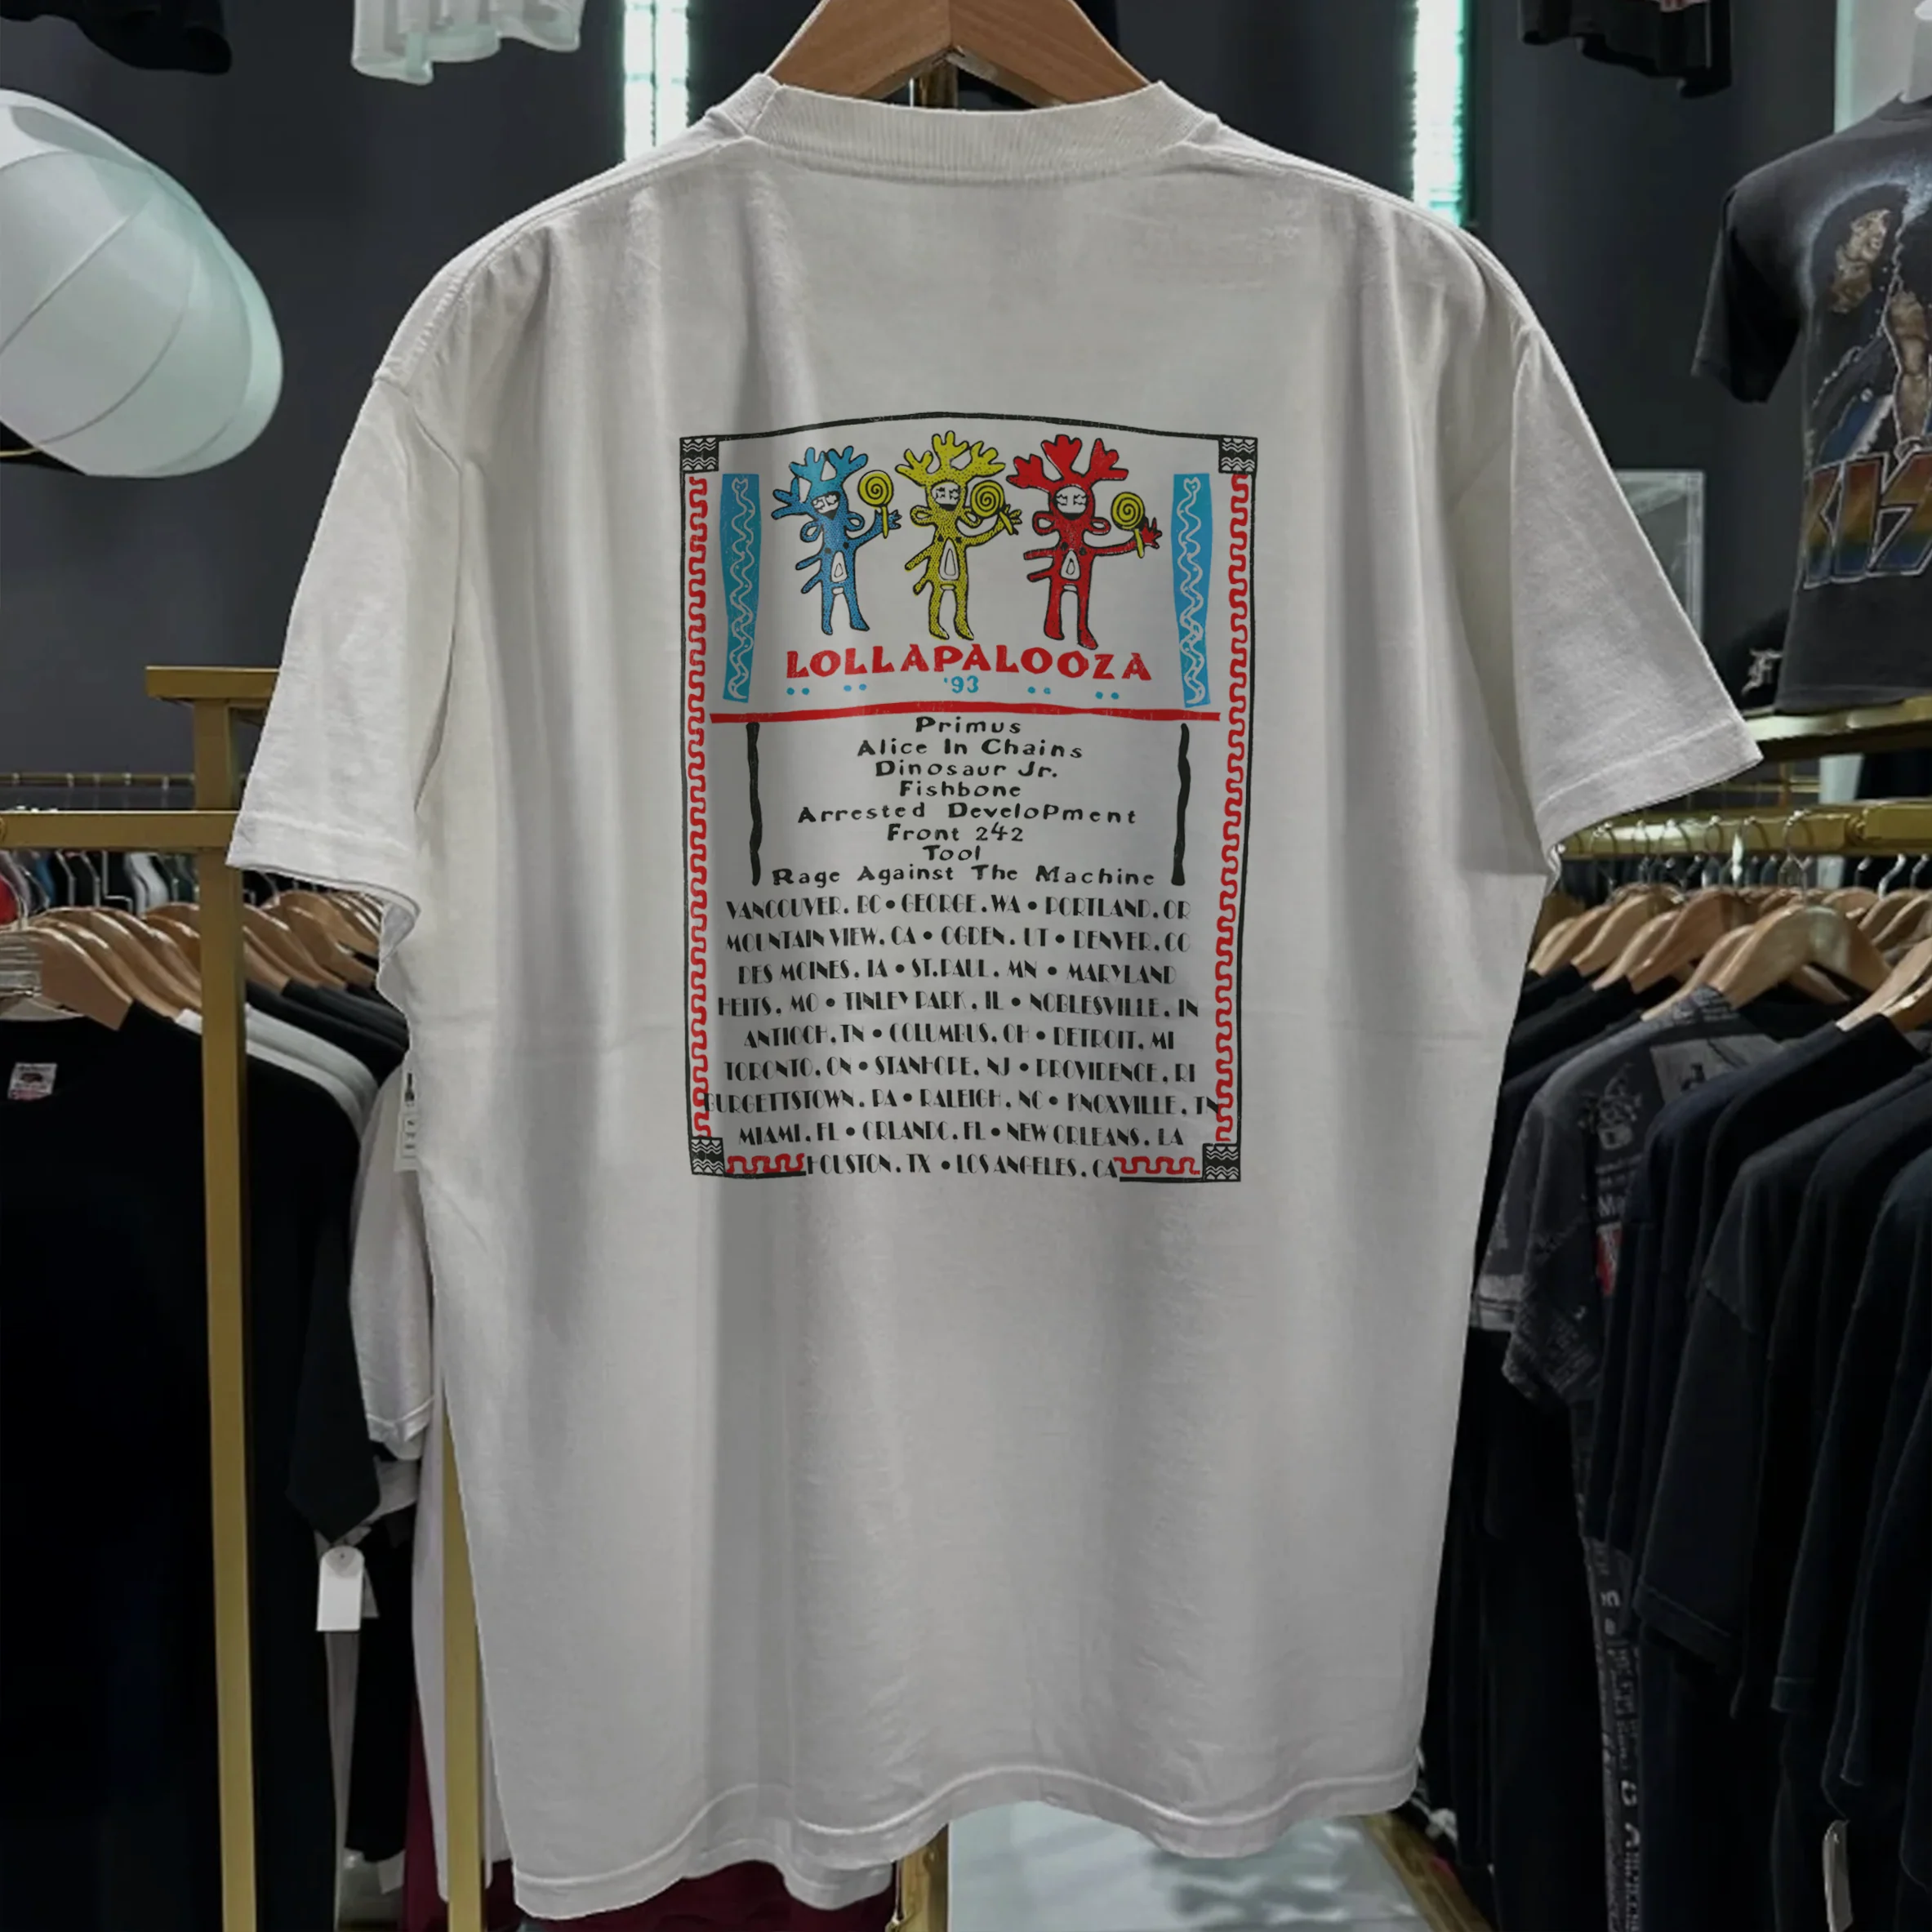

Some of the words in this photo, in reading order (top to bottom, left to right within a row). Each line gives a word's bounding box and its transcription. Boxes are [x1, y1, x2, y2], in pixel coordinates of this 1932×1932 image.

[786, 643, 1152, 681] LOLLAPALOOZA
[915, 715, 1021, 734] Primus
[857, 737, 927, 757] Alice
[944, 738, 968, 755] In
[982, 738, 1082, 759] Chains
[875, 759, 1007, 777] Dinosaur
[1017, 761, 1057, 777] Jr.
[899, 780, 1021, 797] Fishbone
[798, 801, 924, 825] Arrested
[887, 823, 959, 842] Front
[976, 821, 1023, 842] 242
[922, 844, 981, 861] Tool
[772, 868, 840, 888] Rage
[857, 863, 953, 886] Against
[971, 864, 1017, 881] The
[1035, 865, 1154, 885] Machine
[857, 894, 881, 914] BC
[1164, 900, 1190, 919] OR
[726, 929, 825, 953] MOUNTAIN
[891, 926, 916, 945] CA
[1024, 928, 1048, 947] UT
[1164, 932, 1190, 952] CO
[738, 964, 772, 985] DES
[867, 959, 888, 978] IA
[1007, 960, 1036, 978] MN
[1066, 963, 1176, 985] MARYLAND
[790, 993, 818, 1013] MO
[844, 991, 908, 1011] TINLEY
[985, 990, 1004, 1010] IL
[1178, 999, 1199, 1017] IN
[840, 1024, 864, 1043] TN
[1003, 1023, 1029, 1044] OH
[1151, 1031, 1173, 1049] MI
[826, 1057, 852, 1075] ON
[1175, 1063, 1195, 1083] RI
[872, 1088, 897, 1107] PA
[1018, 1089, 1043, 1110] NC
[1195, 1096, 1219, 1115] TN
[1007, 1122, 1048, 1142] NEW
[1158, 1128, 1184, 1146] LA
[906, 1153, 931, 1173] TX
[956, 1154, 989, 1173] LOS
[1093, 1159, 1117, 1178] CA
